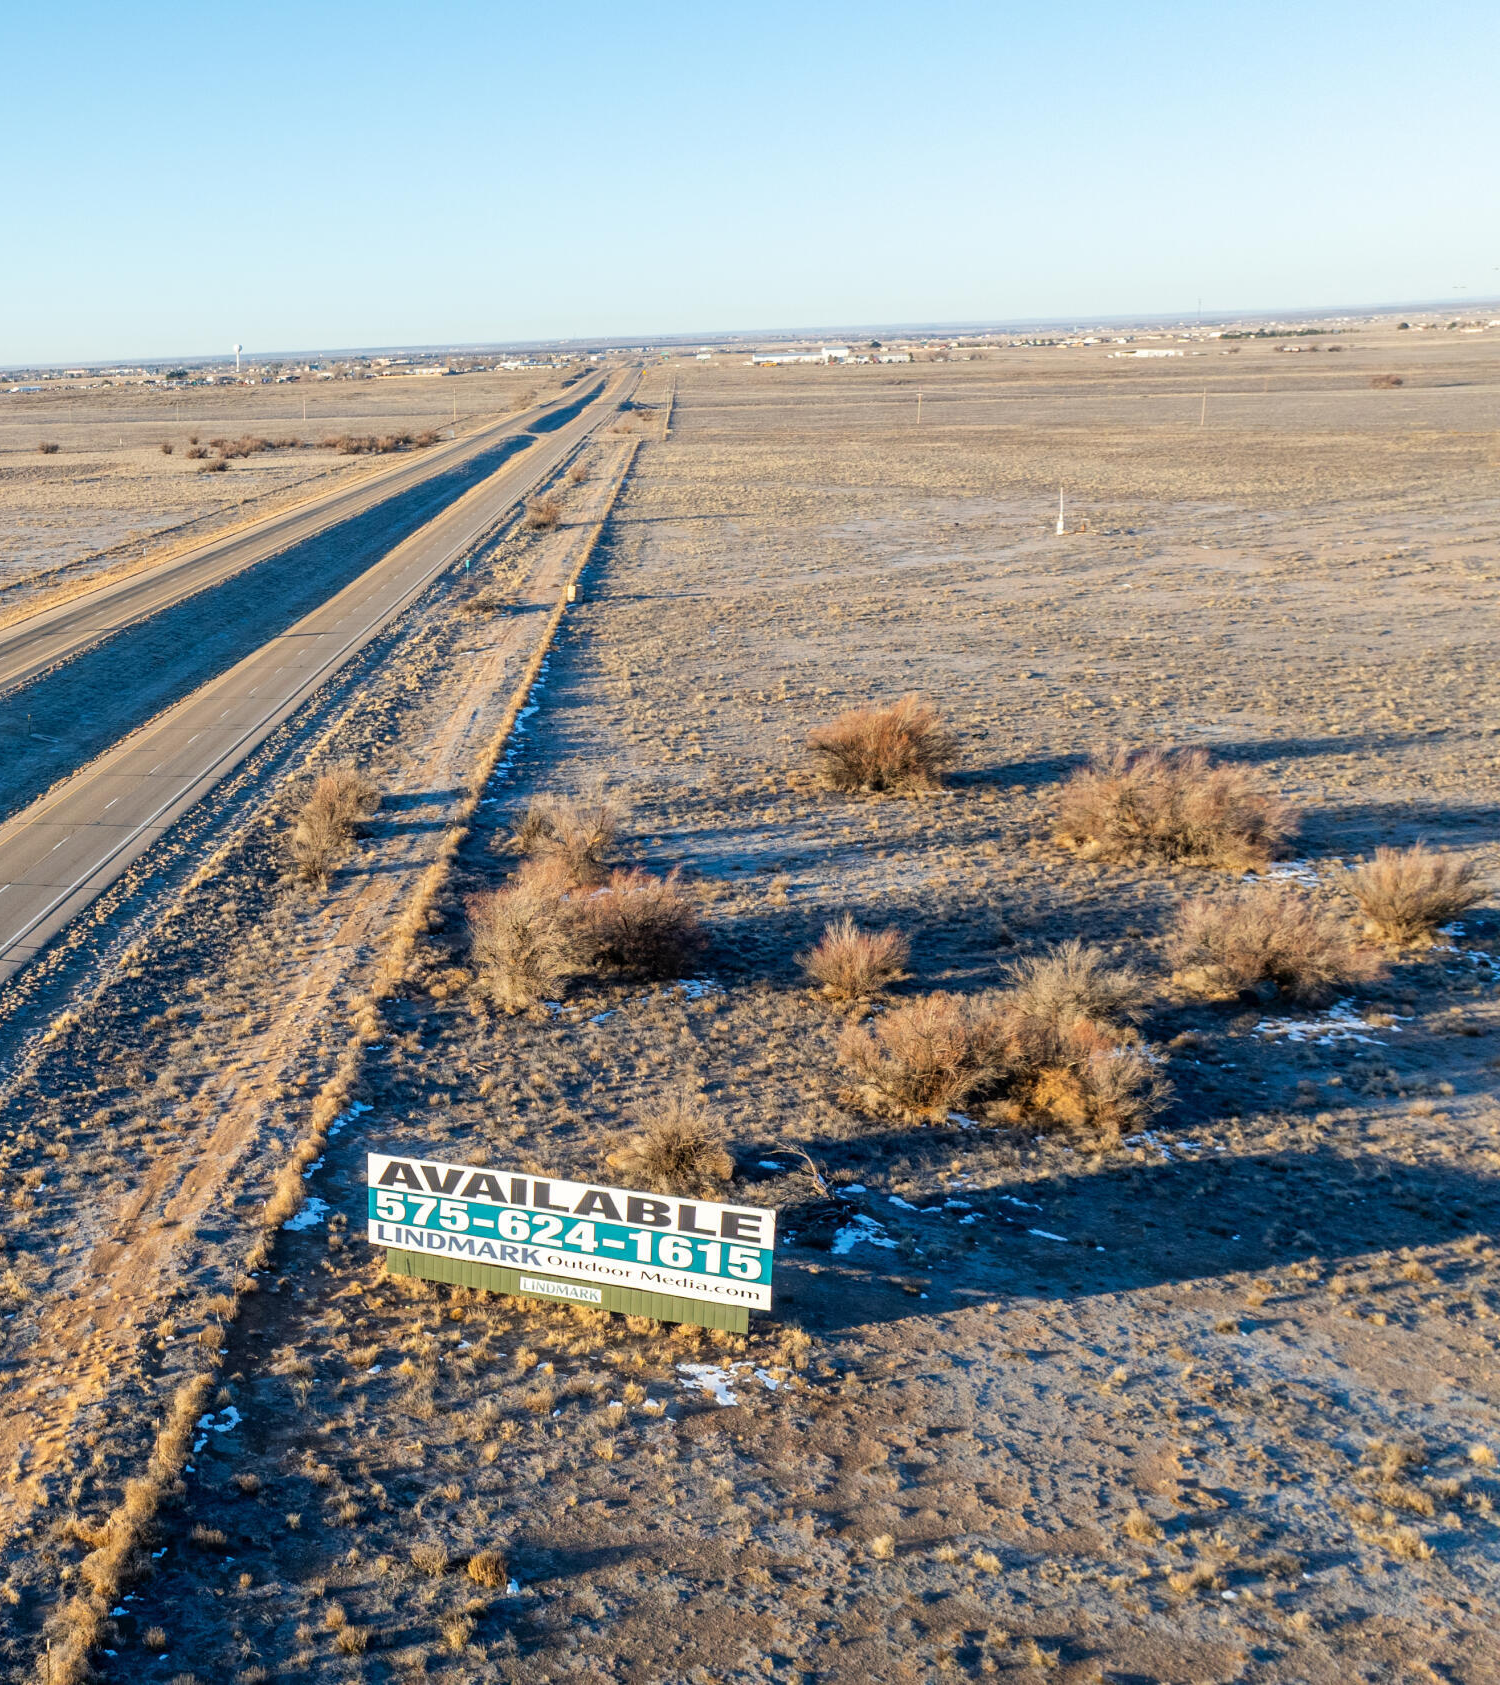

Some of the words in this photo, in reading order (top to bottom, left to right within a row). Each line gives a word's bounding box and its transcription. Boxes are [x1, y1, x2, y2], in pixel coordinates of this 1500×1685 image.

[376, 1190, 762, 1280] 575-624-1615
[378, 1161, 762, 1243] AVAILABLE
[377, 1224, 541, 1266] LINDMARK
[547, 1255, 632, 1278] Outdoor
[640, 1270, 760, 1300] Media.com
[523, 1278, 599, 1301] LINDMARK
